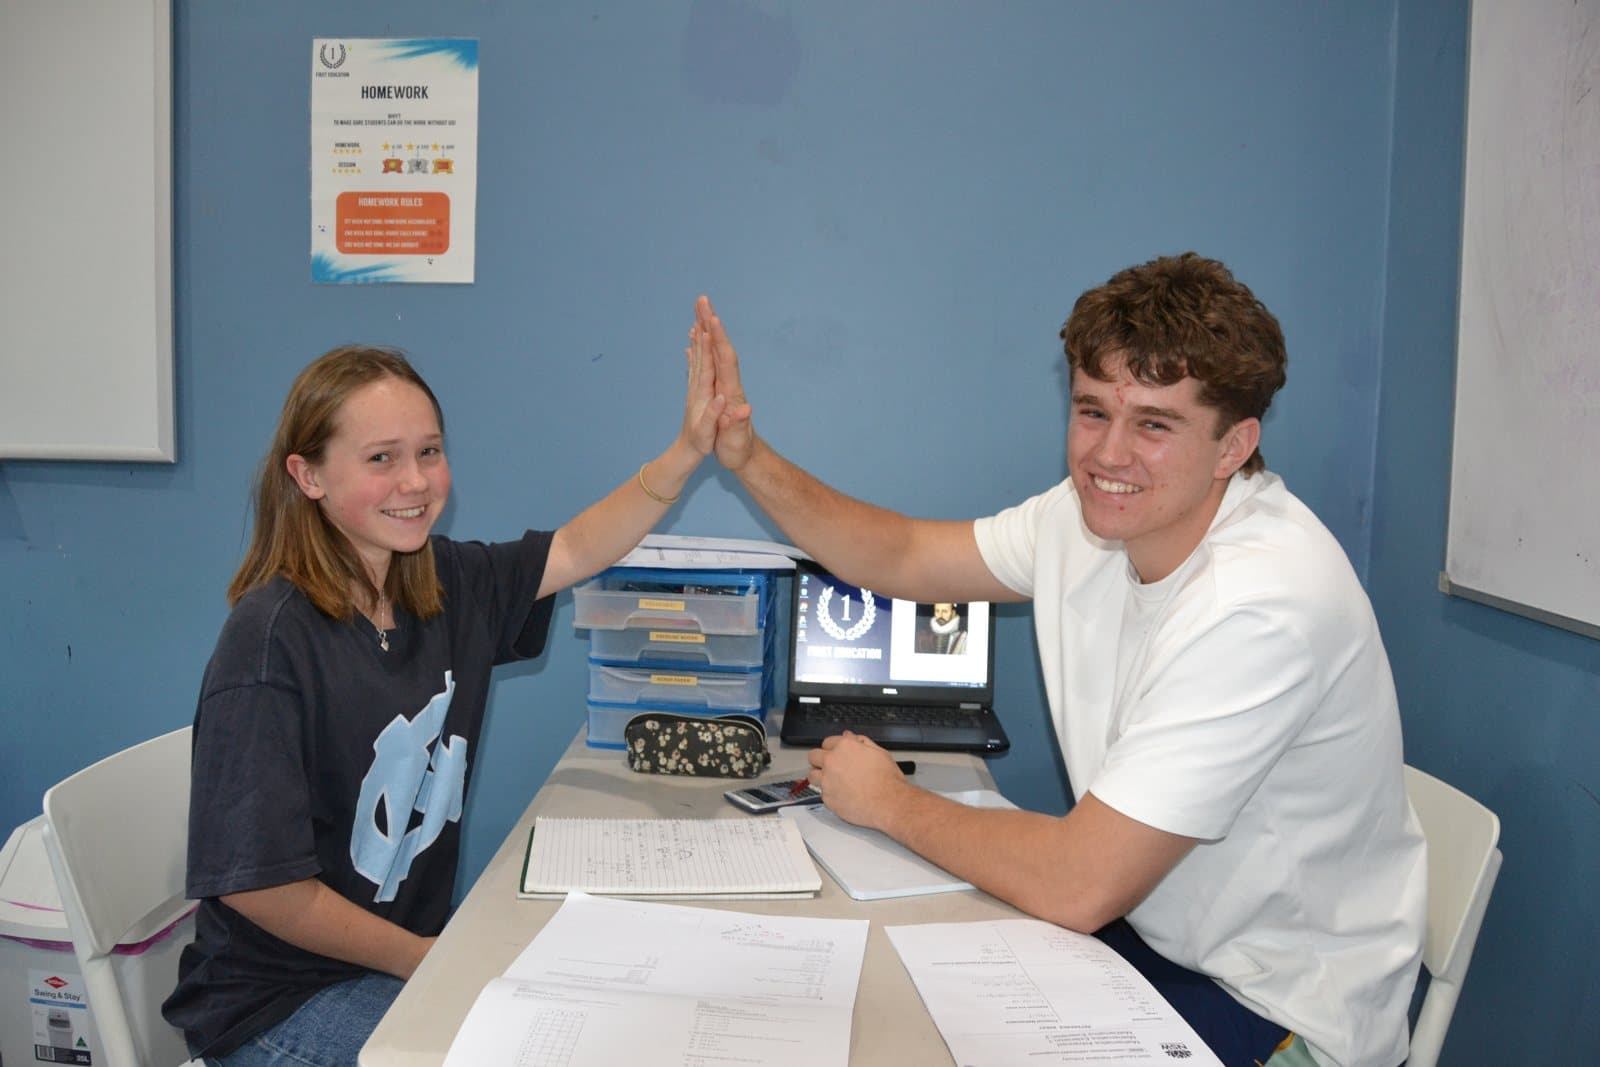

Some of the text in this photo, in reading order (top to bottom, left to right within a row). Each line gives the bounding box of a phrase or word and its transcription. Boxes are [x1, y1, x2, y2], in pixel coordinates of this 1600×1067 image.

[361, 86, 428, 99] HOMEWORK
[358, 197, 423, 207] HOMEWORK RULES
[841, 594, 851, 621] 1
[34, 989, 81, 1002] Swing & Stay
